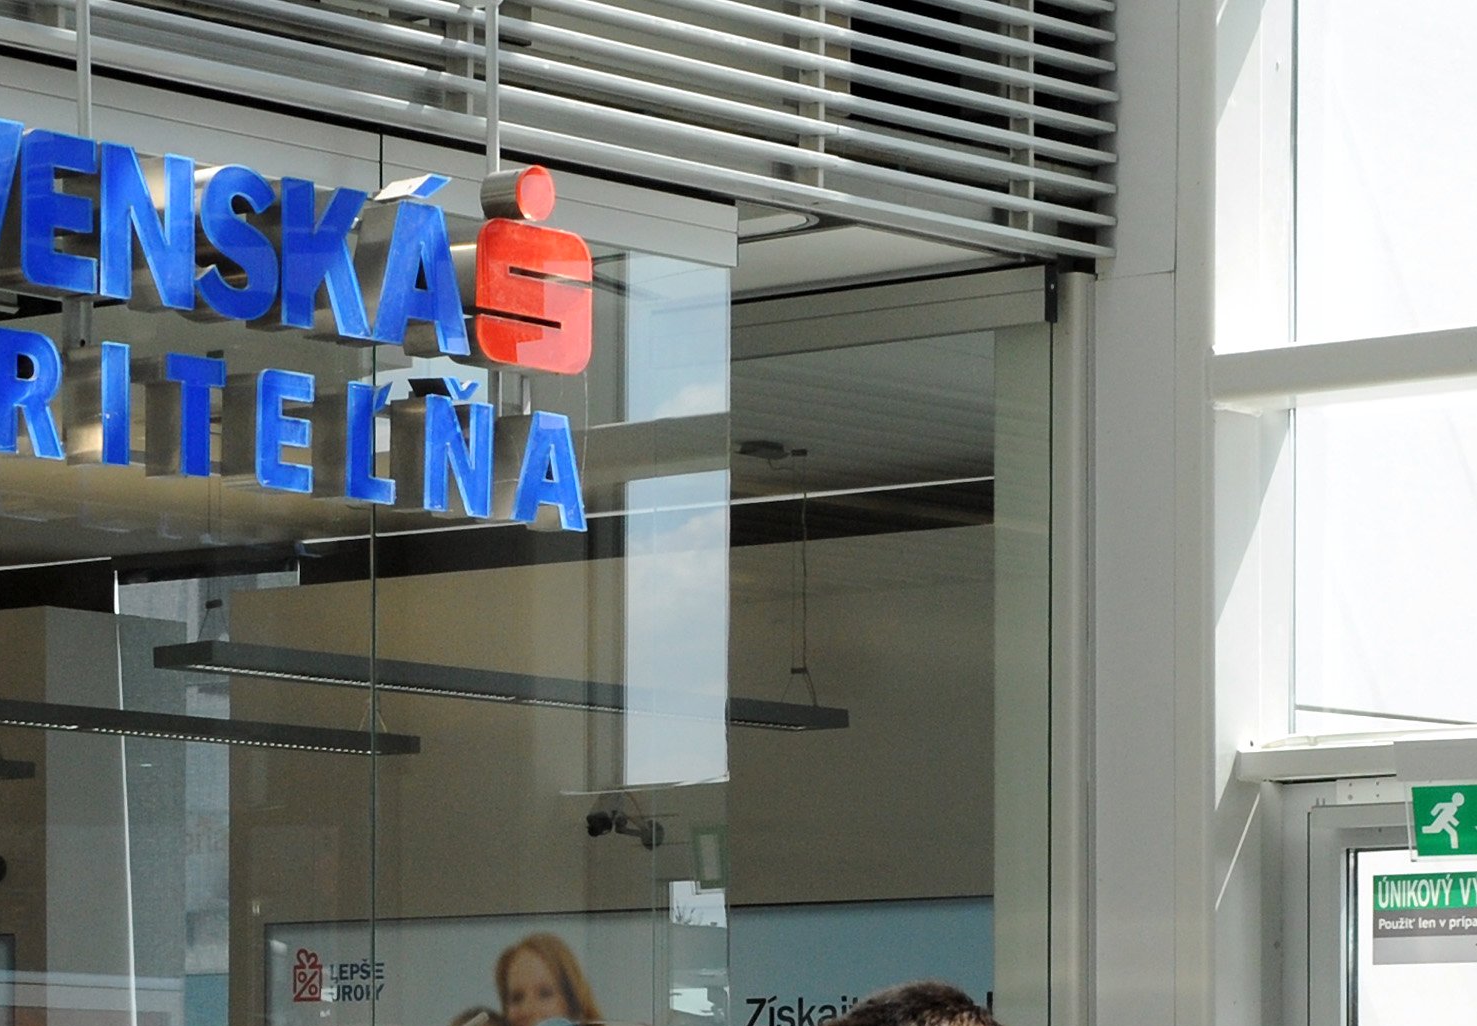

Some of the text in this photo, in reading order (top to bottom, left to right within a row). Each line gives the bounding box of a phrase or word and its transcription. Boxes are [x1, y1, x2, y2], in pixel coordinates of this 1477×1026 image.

[1378, 873, 1453, 909] ÚNIKOVÝ
[1378, 917, 1416, 930] Použiť
[1418, 917, 1436, 929] len
[1439, 919, 1446, 928] v
